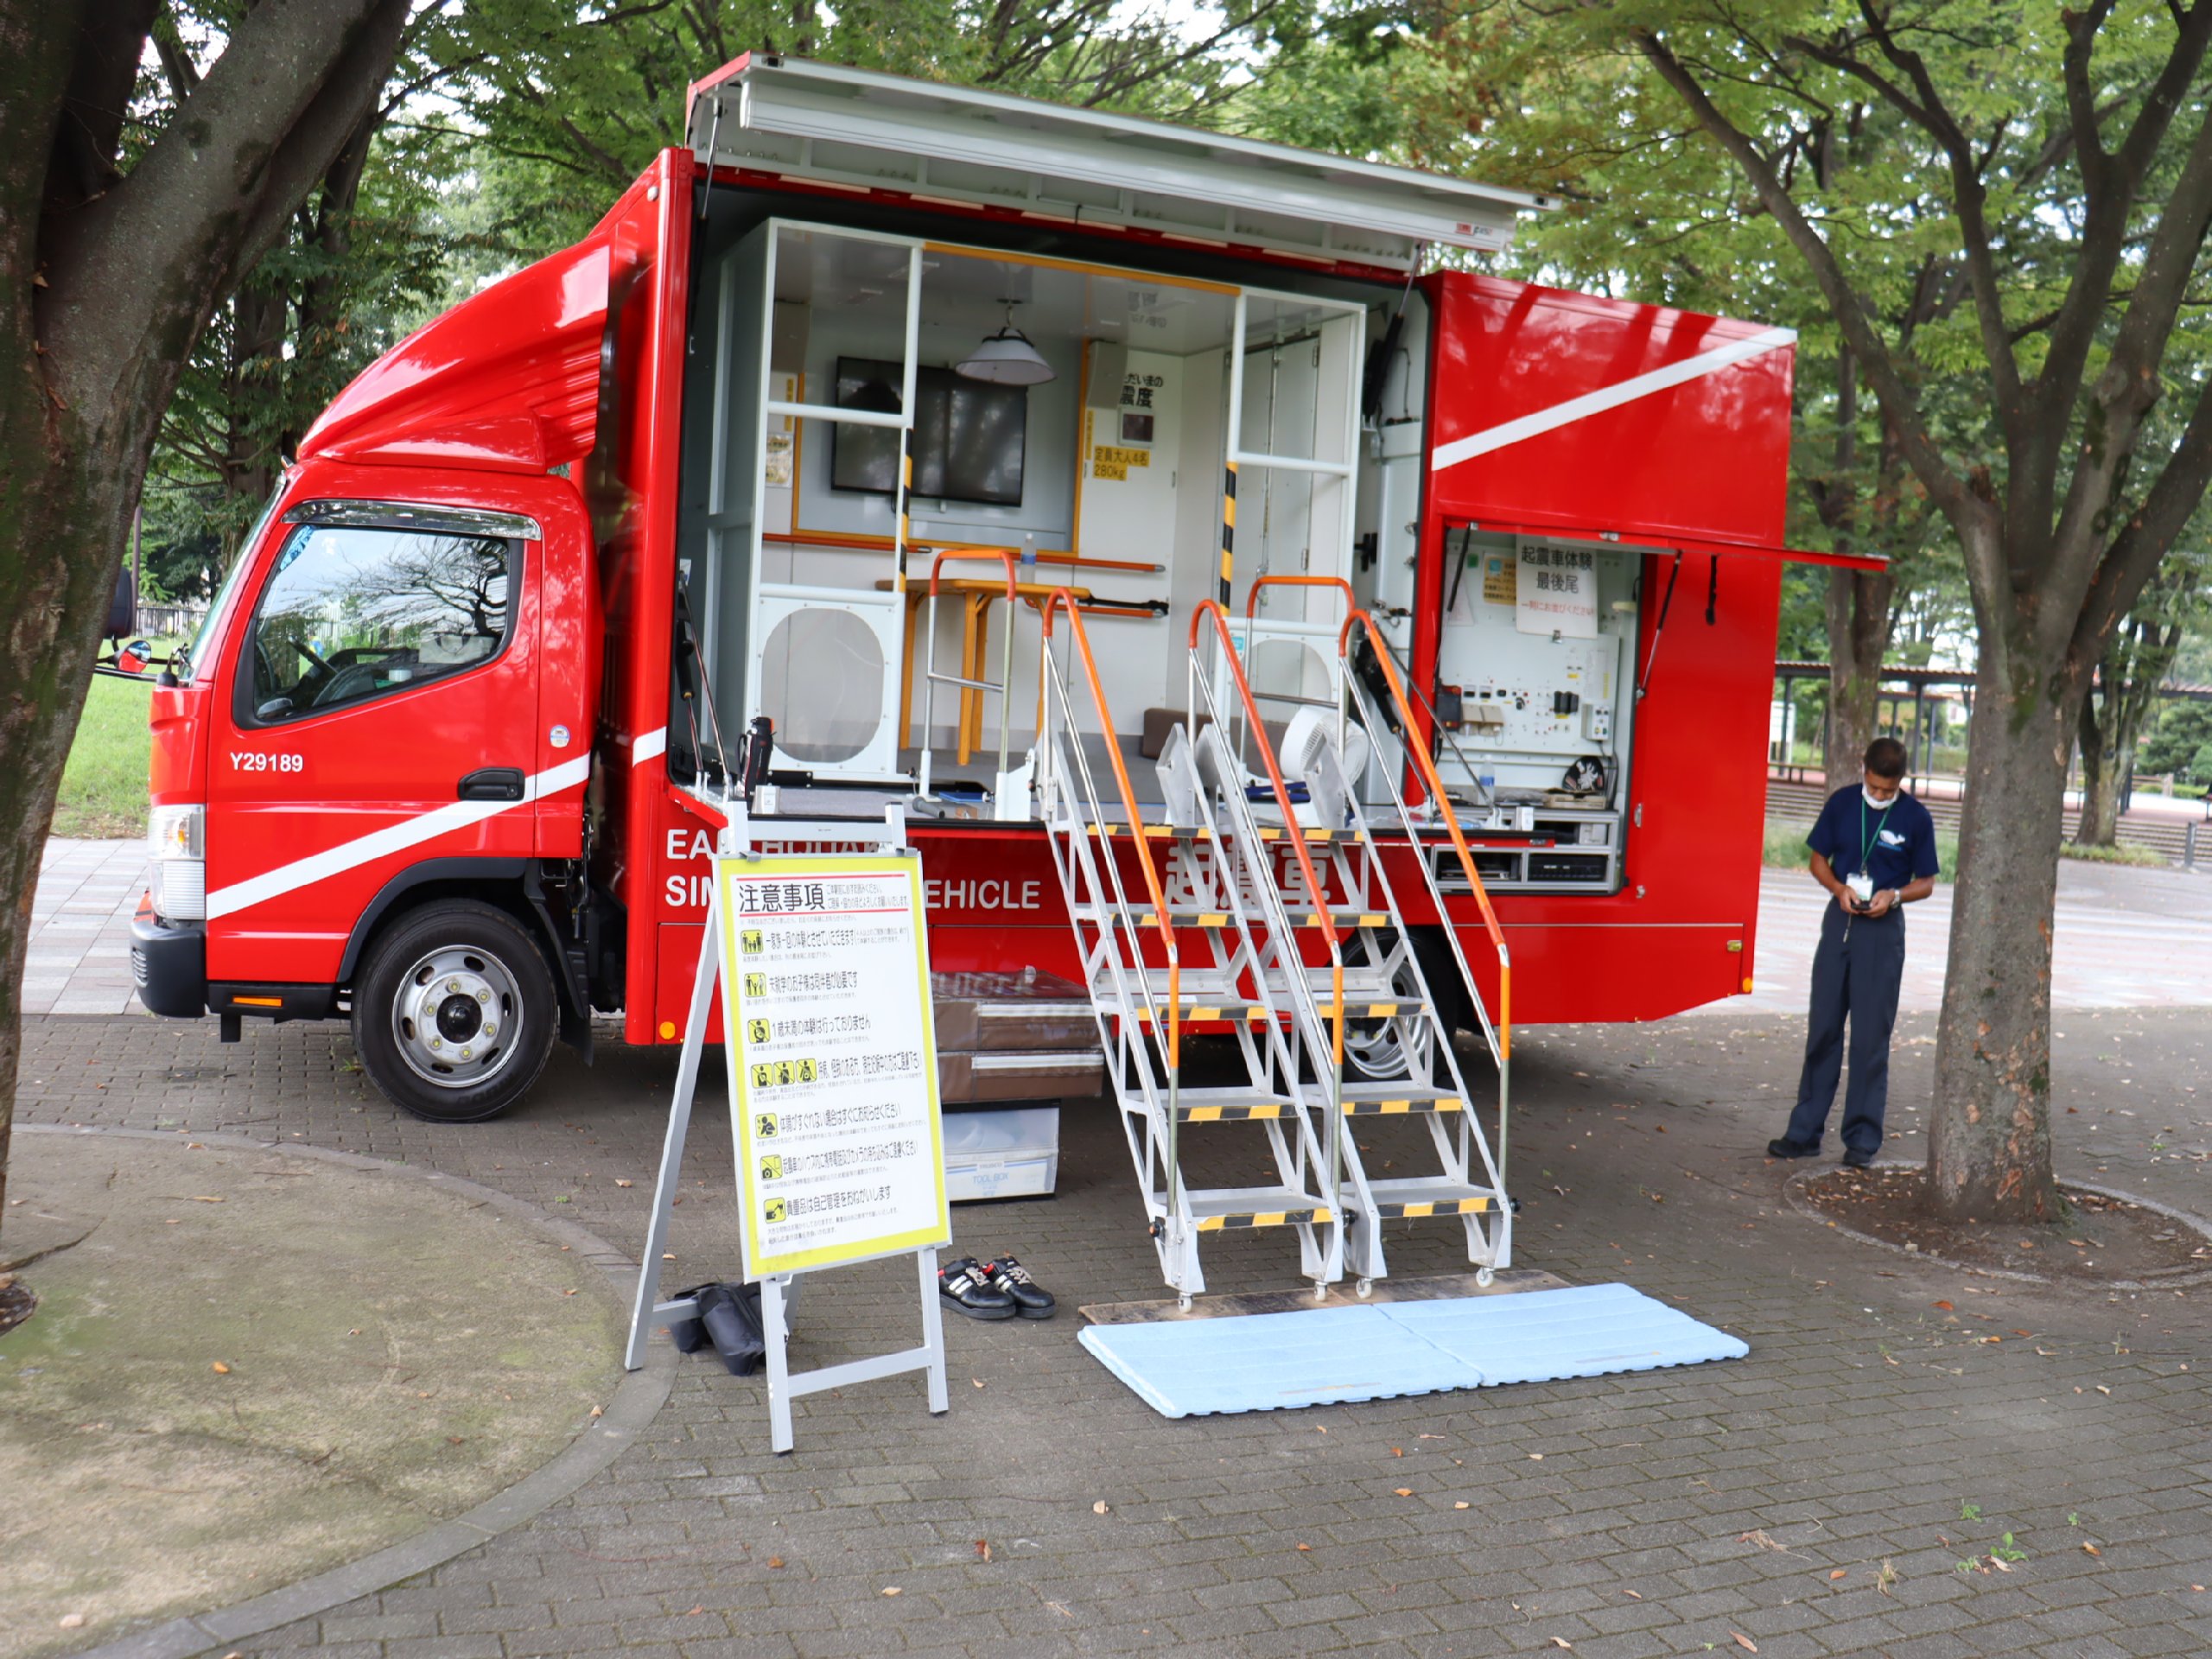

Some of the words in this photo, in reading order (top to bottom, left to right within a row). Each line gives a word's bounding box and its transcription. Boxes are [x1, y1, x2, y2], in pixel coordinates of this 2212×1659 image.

[1120, 385, 1154, 409] 震度
[1095, 448, 1148, 467] 定員大人4名
[1094, 464, 1126, 480] 280kg
[1522, 545, 1592, 571] 起震車体験
[1536, 571, 1580, 594] 最後尾
[1521, 601, 1594, 616] 一列にお並びください
[230, 752, 303, 772] Y29189
[740, 883, 825, 912] 注意事項
[769, 971, 858, 994] 未就学のお子様は同伴者が必要です
[779, 1103, 900, 1133] 体調がすぐれない場合はすぐにお知らせください
[786, 1185, 892, 1217] 貴重品は自己管理をおねがいします
